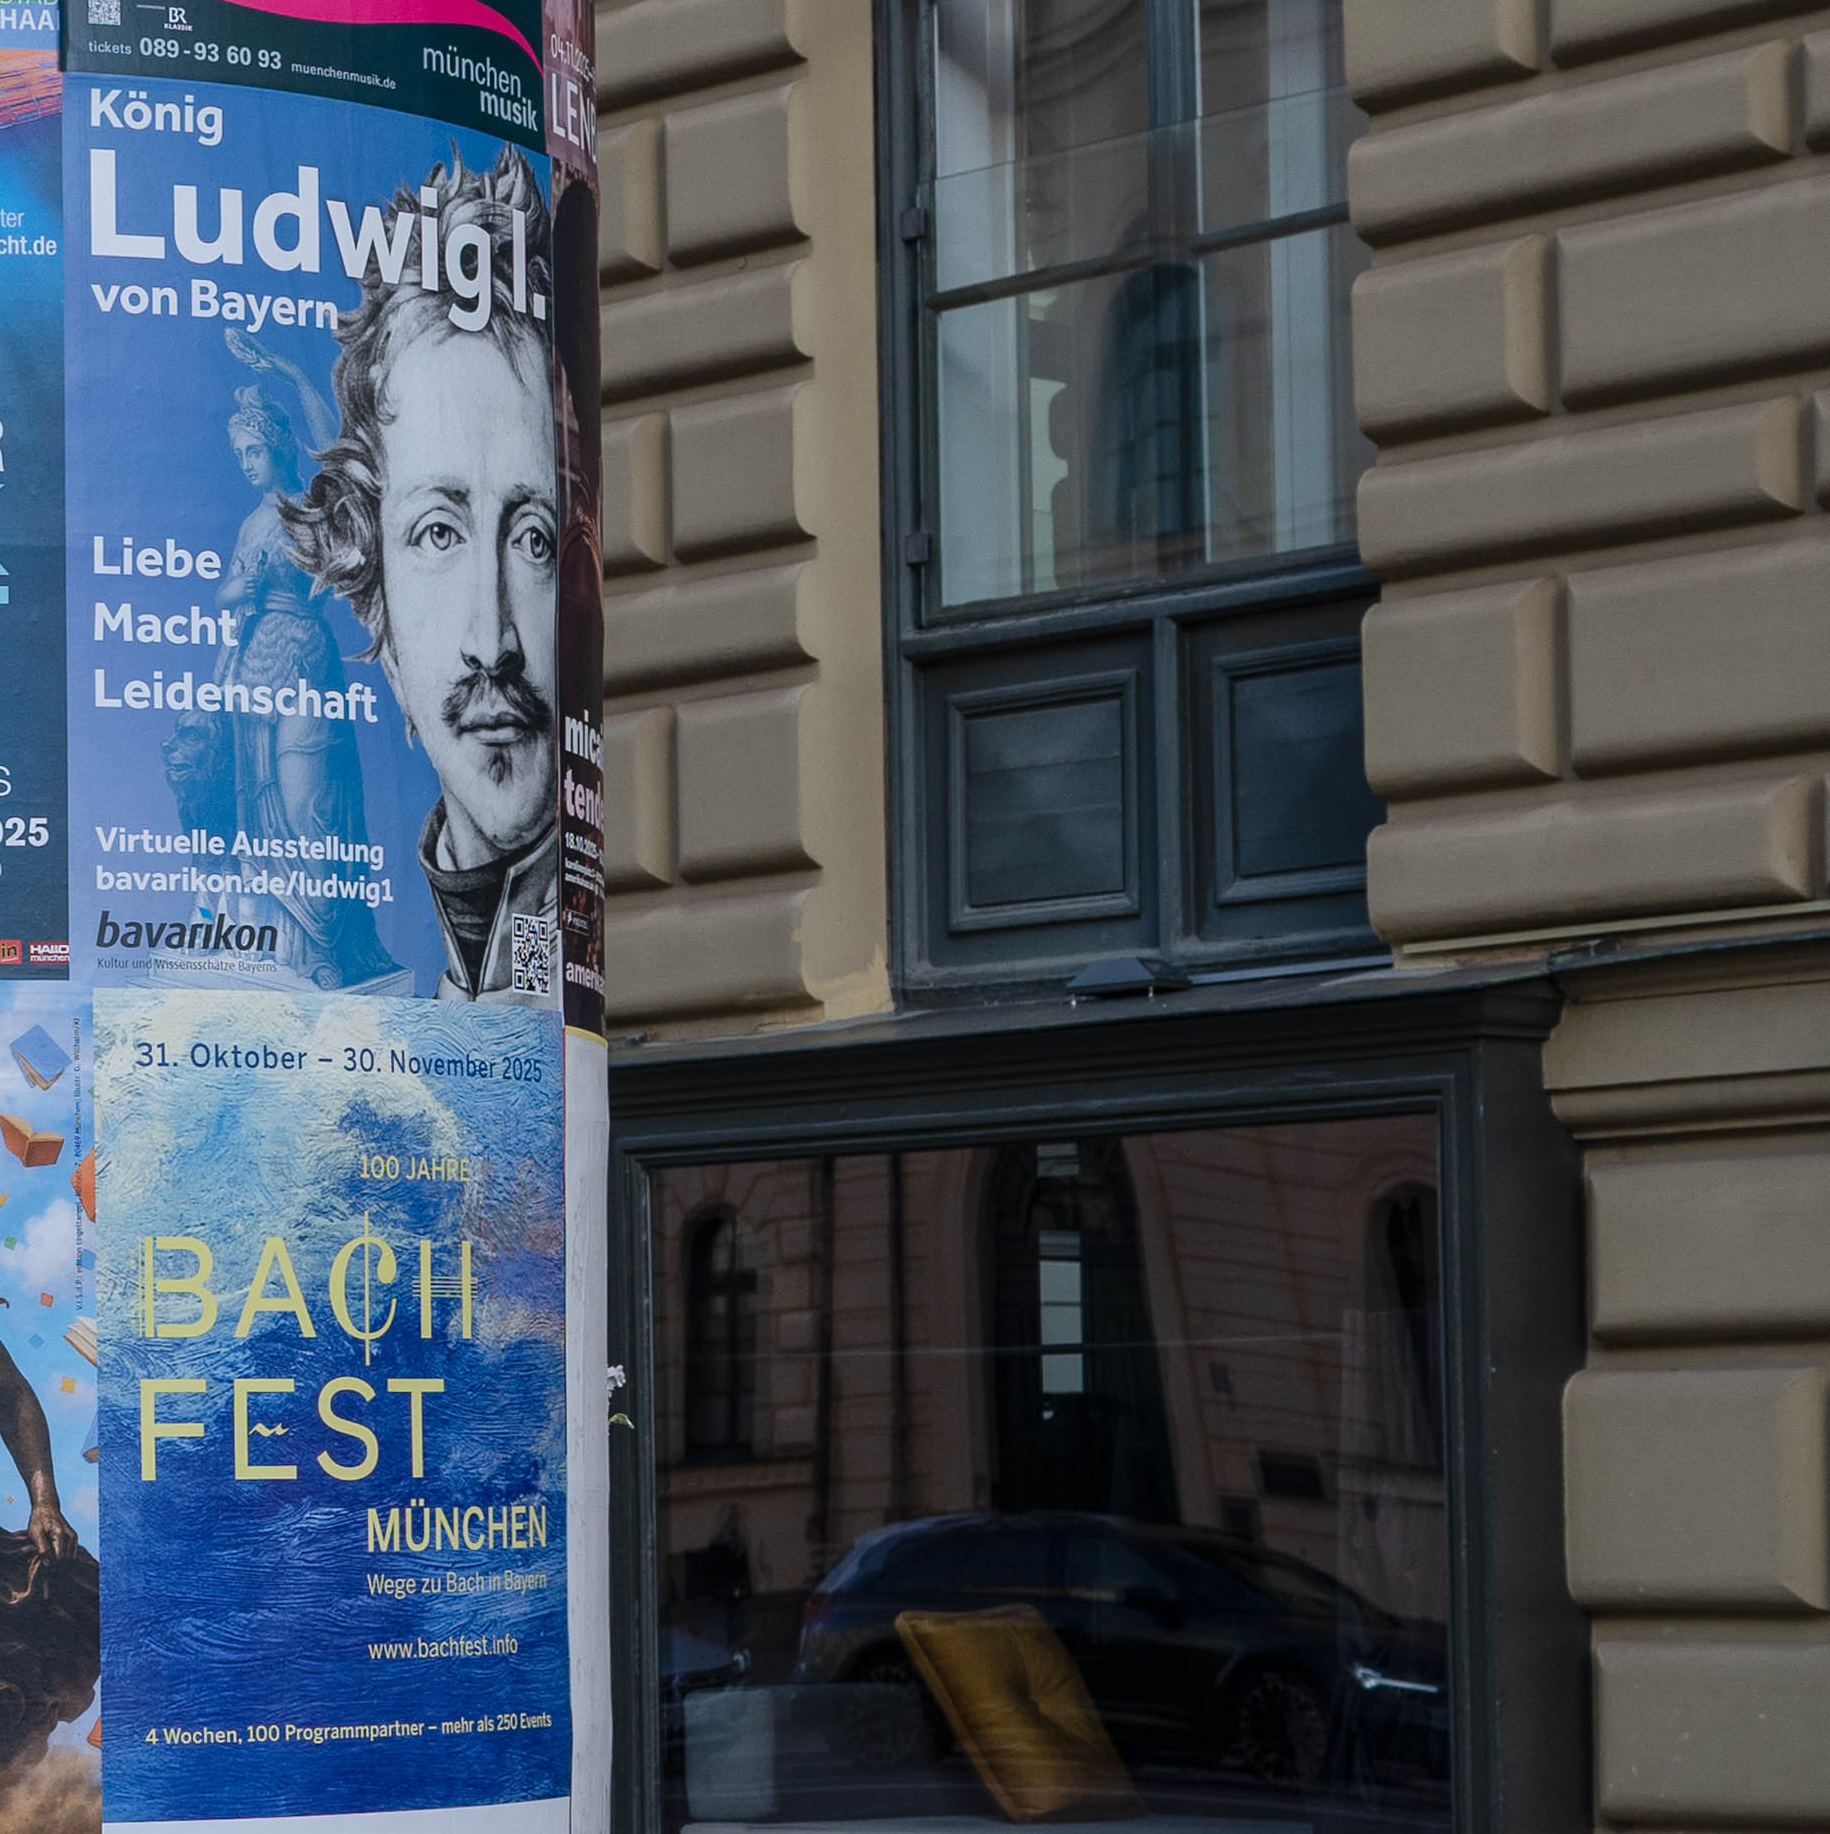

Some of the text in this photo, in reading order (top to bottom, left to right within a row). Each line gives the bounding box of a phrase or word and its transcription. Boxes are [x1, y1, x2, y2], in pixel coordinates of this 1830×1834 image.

[291, 60, 396, 91] muenchenmusik.de
[423, 45, 521, 98] münchen
[90, 88, 224, 147] König
[480, 89, 538, 132] musik
[90, 148, 491, 332] Ludwig
[90, 279, 339, 334] von Bayern
[93, 535, 221, 580] Liebe
[94, 602, 239, 647] Macht
[94, 668, 378, 723] Leidenschaft
[96, 826, 384, 871] Virtuelle Ausstellung
[96, 865, 394, 908] bavarikon.de/ludwig1
[96, 908, 277, 952] bavarikon
[135, 1042, 541, 1083] 31. Oktober 30. November 2025
[360, 1155, 470, 1181] 100 JAHRE
[136, 1212, 478, 1365] BACH
[140, 1377, 445, 1480] FEST
[368, 1499, 547, 1553] MÜNCHEN
[368, 1635, 518, 1659] www.bachfest.info
